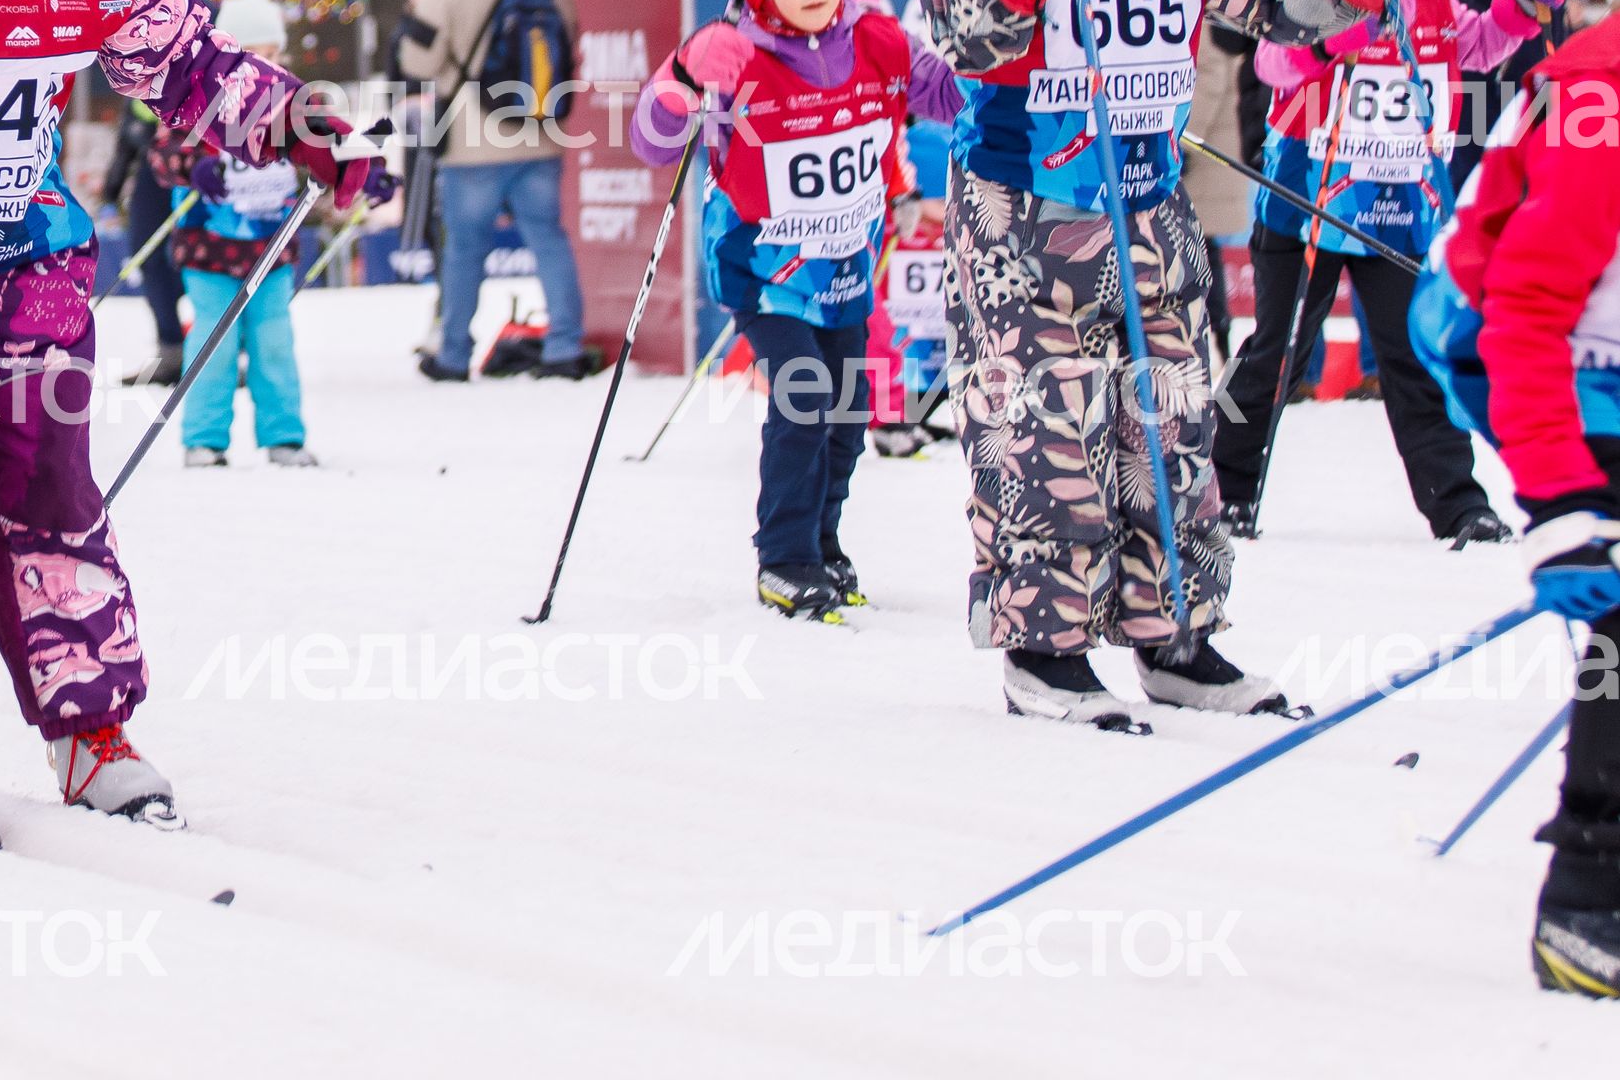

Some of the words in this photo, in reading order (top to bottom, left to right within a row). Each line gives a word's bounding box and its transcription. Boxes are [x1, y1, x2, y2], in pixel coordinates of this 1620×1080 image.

[52, 26, 82, 38] ЗИМА
[5, 38, 40, 48] marsport
[1033, 67, 1195, 104] МАНОСОВСКА
[1110, 110, 1163, 131] ЛЫЖНЯ
[1313, 134, 1452, 160] МНЖОСОВСАЯ
[1124, 163, 1154, 180] ПАРК
[1367, 166, 1410, 177] ЛЫЖНЯ
[1373, 199, 1401, 212] ПАРК
